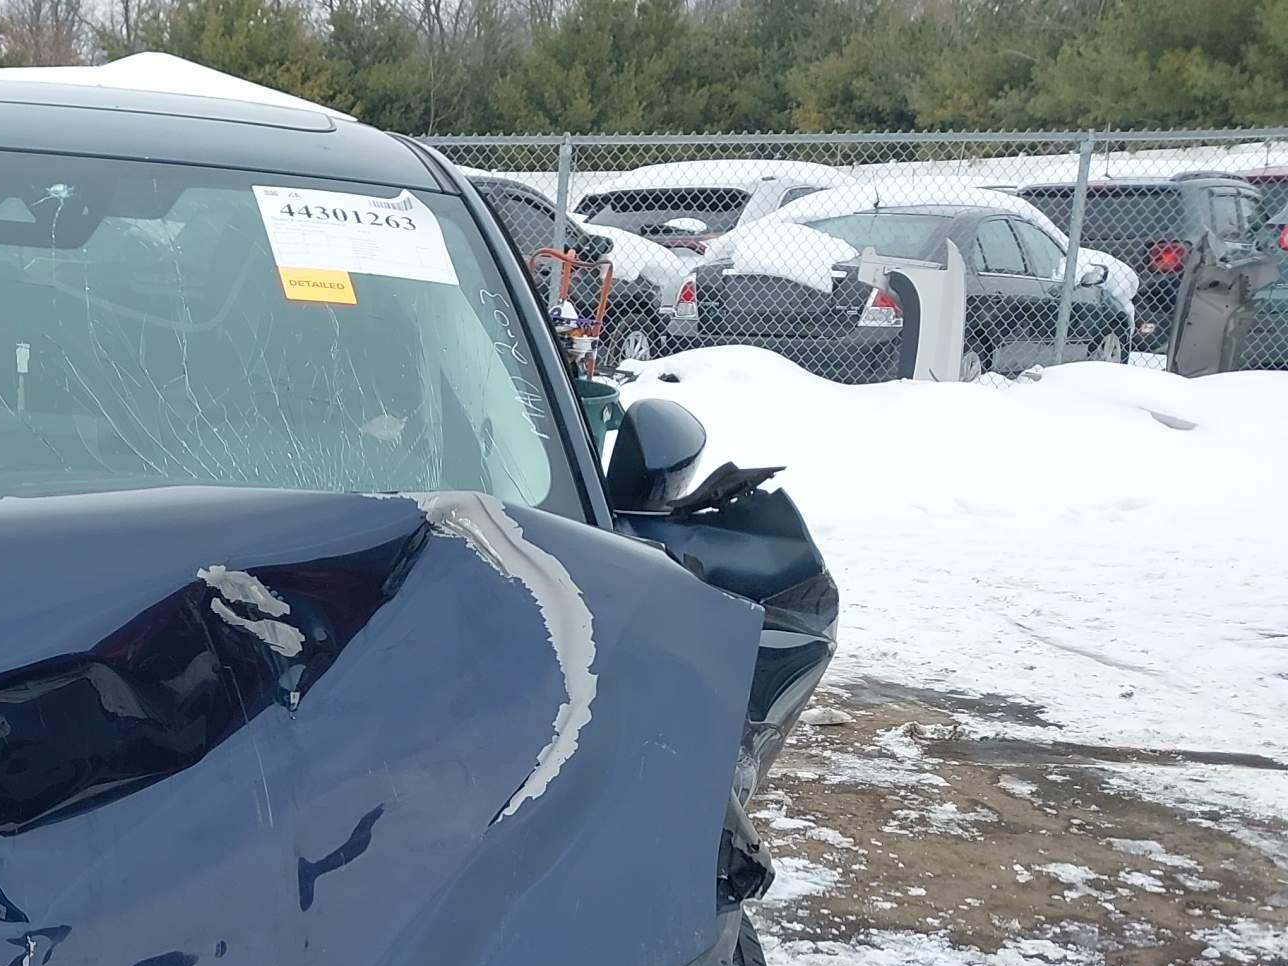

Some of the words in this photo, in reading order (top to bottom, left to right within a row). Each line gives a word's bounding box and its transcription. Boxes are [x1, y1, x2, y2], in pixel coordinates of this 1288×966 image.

[279, 203, 417, 231] 44301263
[288, 278, 346, 291] DETAILED
[479, 288, 529, 365] 2-03
